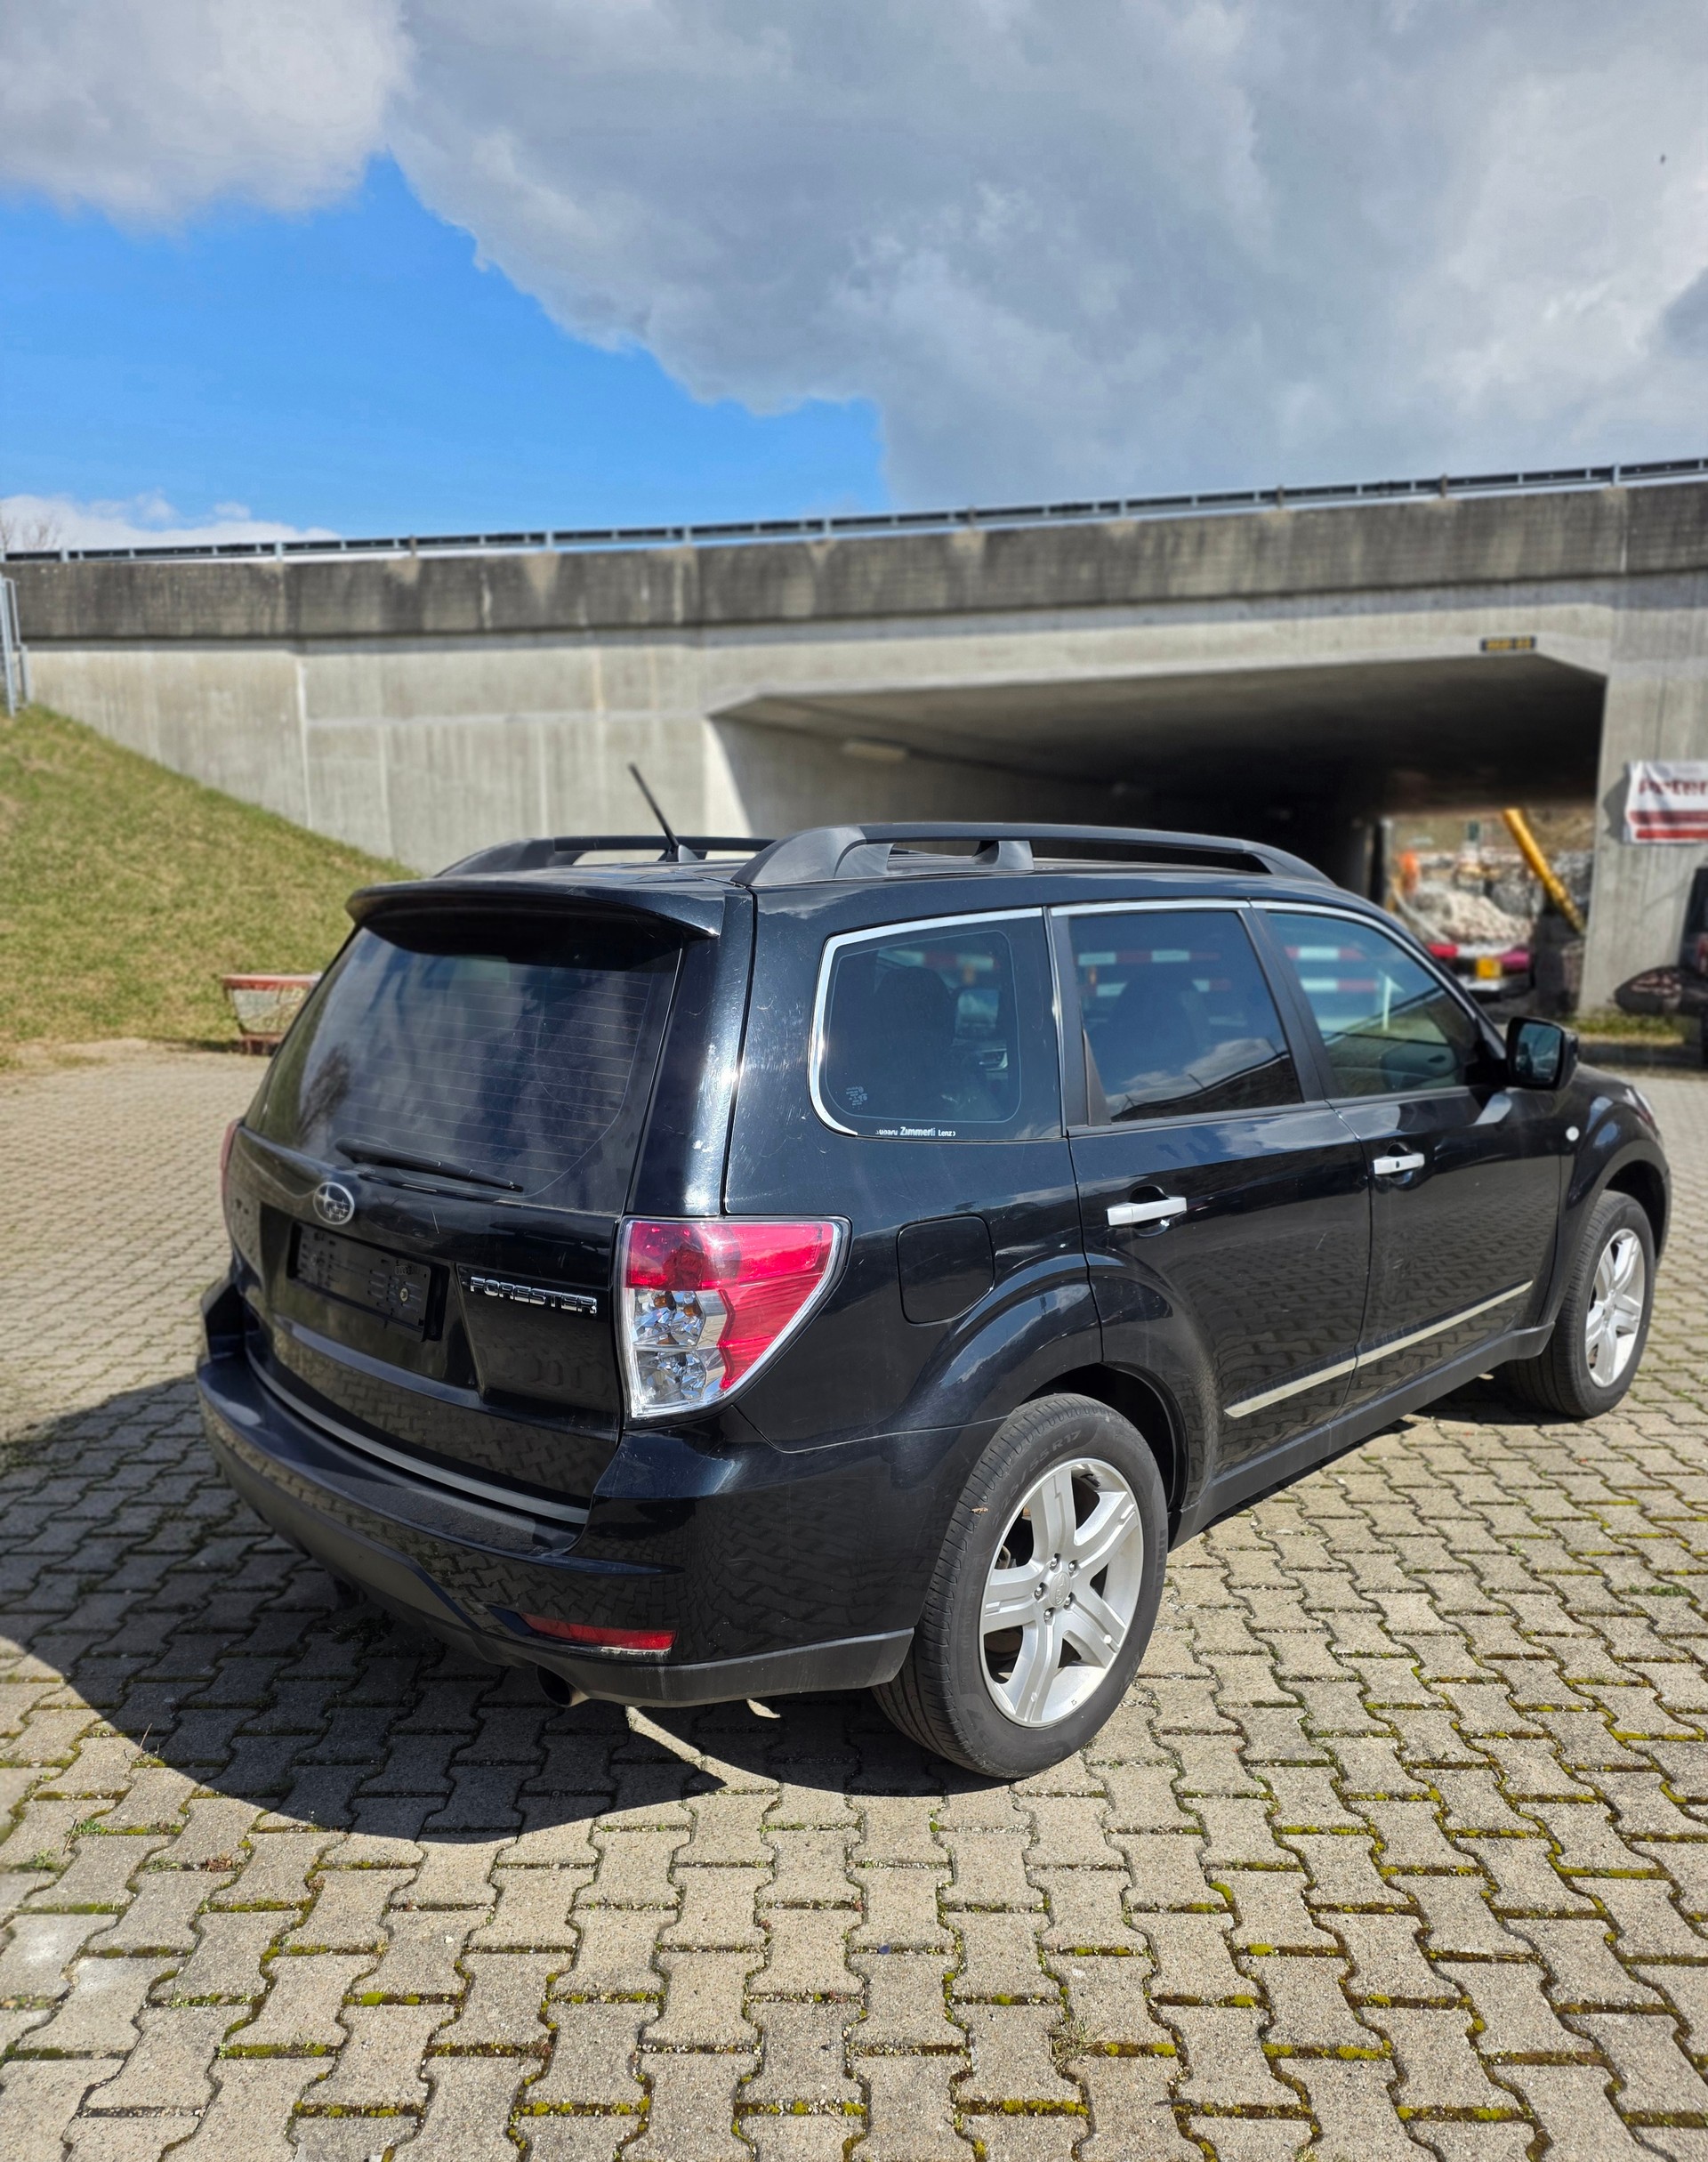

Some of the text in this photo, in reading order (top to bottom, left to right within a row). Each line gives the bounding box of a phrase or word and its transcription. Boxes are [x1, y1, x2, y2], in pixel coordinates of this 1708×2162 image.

[899, 1125, 936, 1137] Zimmerli
[470, 1276, 598, 1315] FORESTER
[1051, 1430, 1082, 1452] R17
